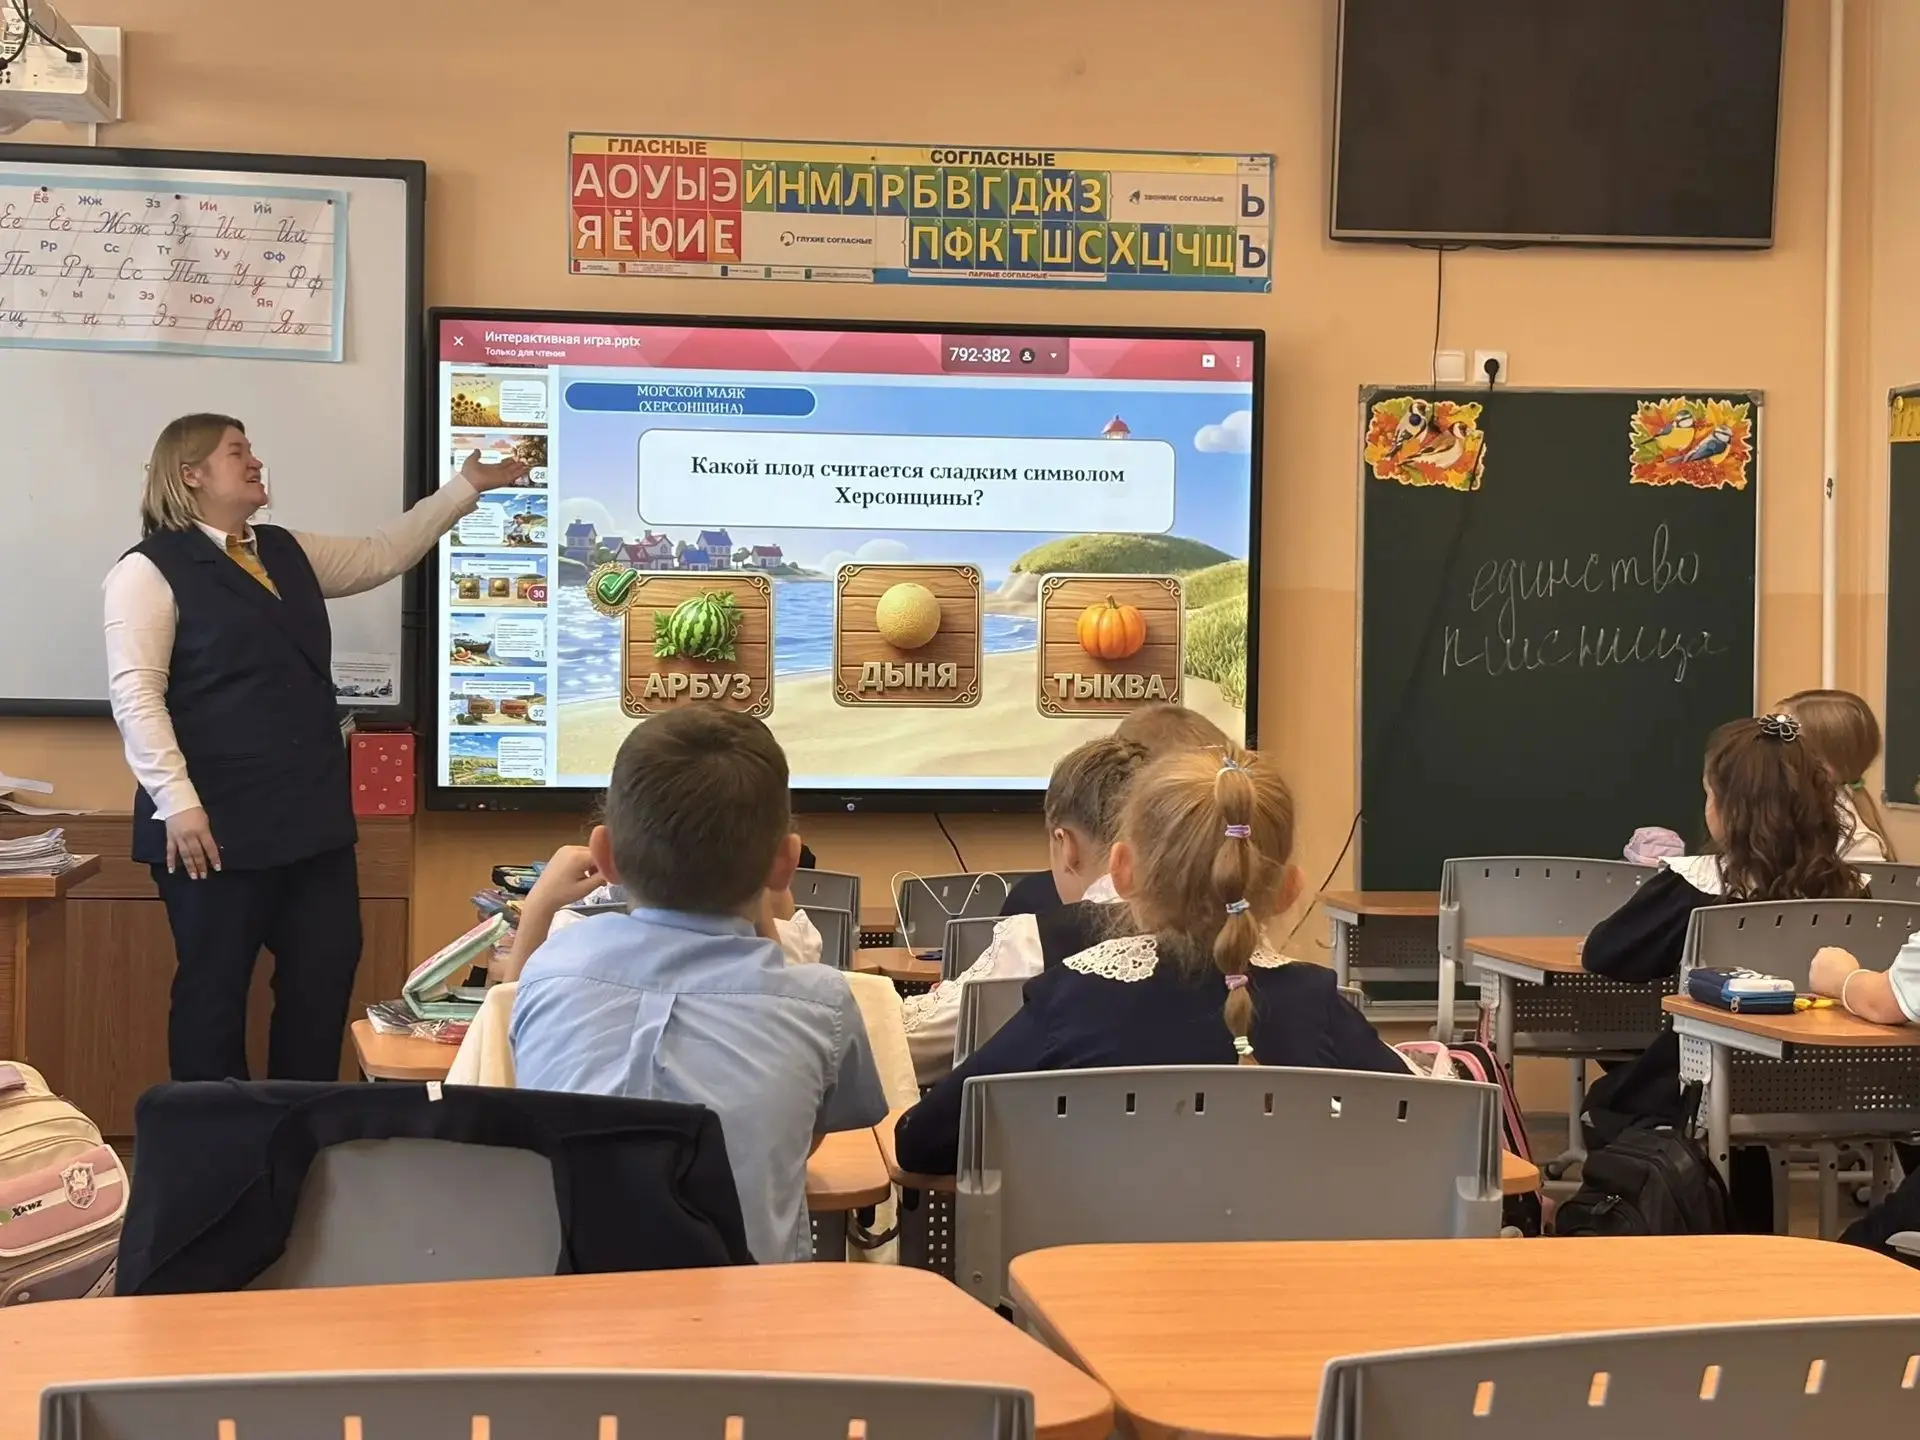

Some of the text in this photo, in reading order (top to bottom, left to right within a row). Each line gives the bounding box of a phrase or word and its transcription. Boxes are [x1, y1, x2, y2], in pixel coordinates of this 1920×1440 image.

[607, 138, 708, 156] ГЛАСНЫЕ
[930, 149, 1056, 168] СОГЛАСНЫЕ
[1178, 195, 1225, 203] СОГЛАСНЫЕ
[1241, 184, 1266, 218] Ь
[199, 202, 218, 212] Ии
[796, 236, 873, 245] ГЛУХИЕ СОГЛАСНЫЕ
[263, 251, 286, 263] Фф
[484, 331, 642, 348] Интерактивная игра.pptx
[485, 347, 516, 357] Только
[535, 350, 566, 358] чтения
[949, 346, 1011, 363] 792-382
[706, 387, 746, 399] МАЯК
[638, 400, 744, 415] (ХЕРСОНЩИНА)
[534, 411, 546, 419] 27
[534, 471, 545, 480] 28
[691, 456, 1125, 483] Какой плод считается сладким символом
[835, 486, 984, 509] Херсонщины?
[534, 531, 546, 539] 29
[1468, 523, 1700, 642] единство
[532, 590, 545, 599] 30
[534, 650, 545, 658] 31
[857, 661, 957, 694] ДЫНЯ
[643, 672, 753, 701] АРБУЗ
[1053, 673, 1168, 701] ТЫКВА
[532, 709, 544, 717] 32
[532, 768, 544, 776] 33
